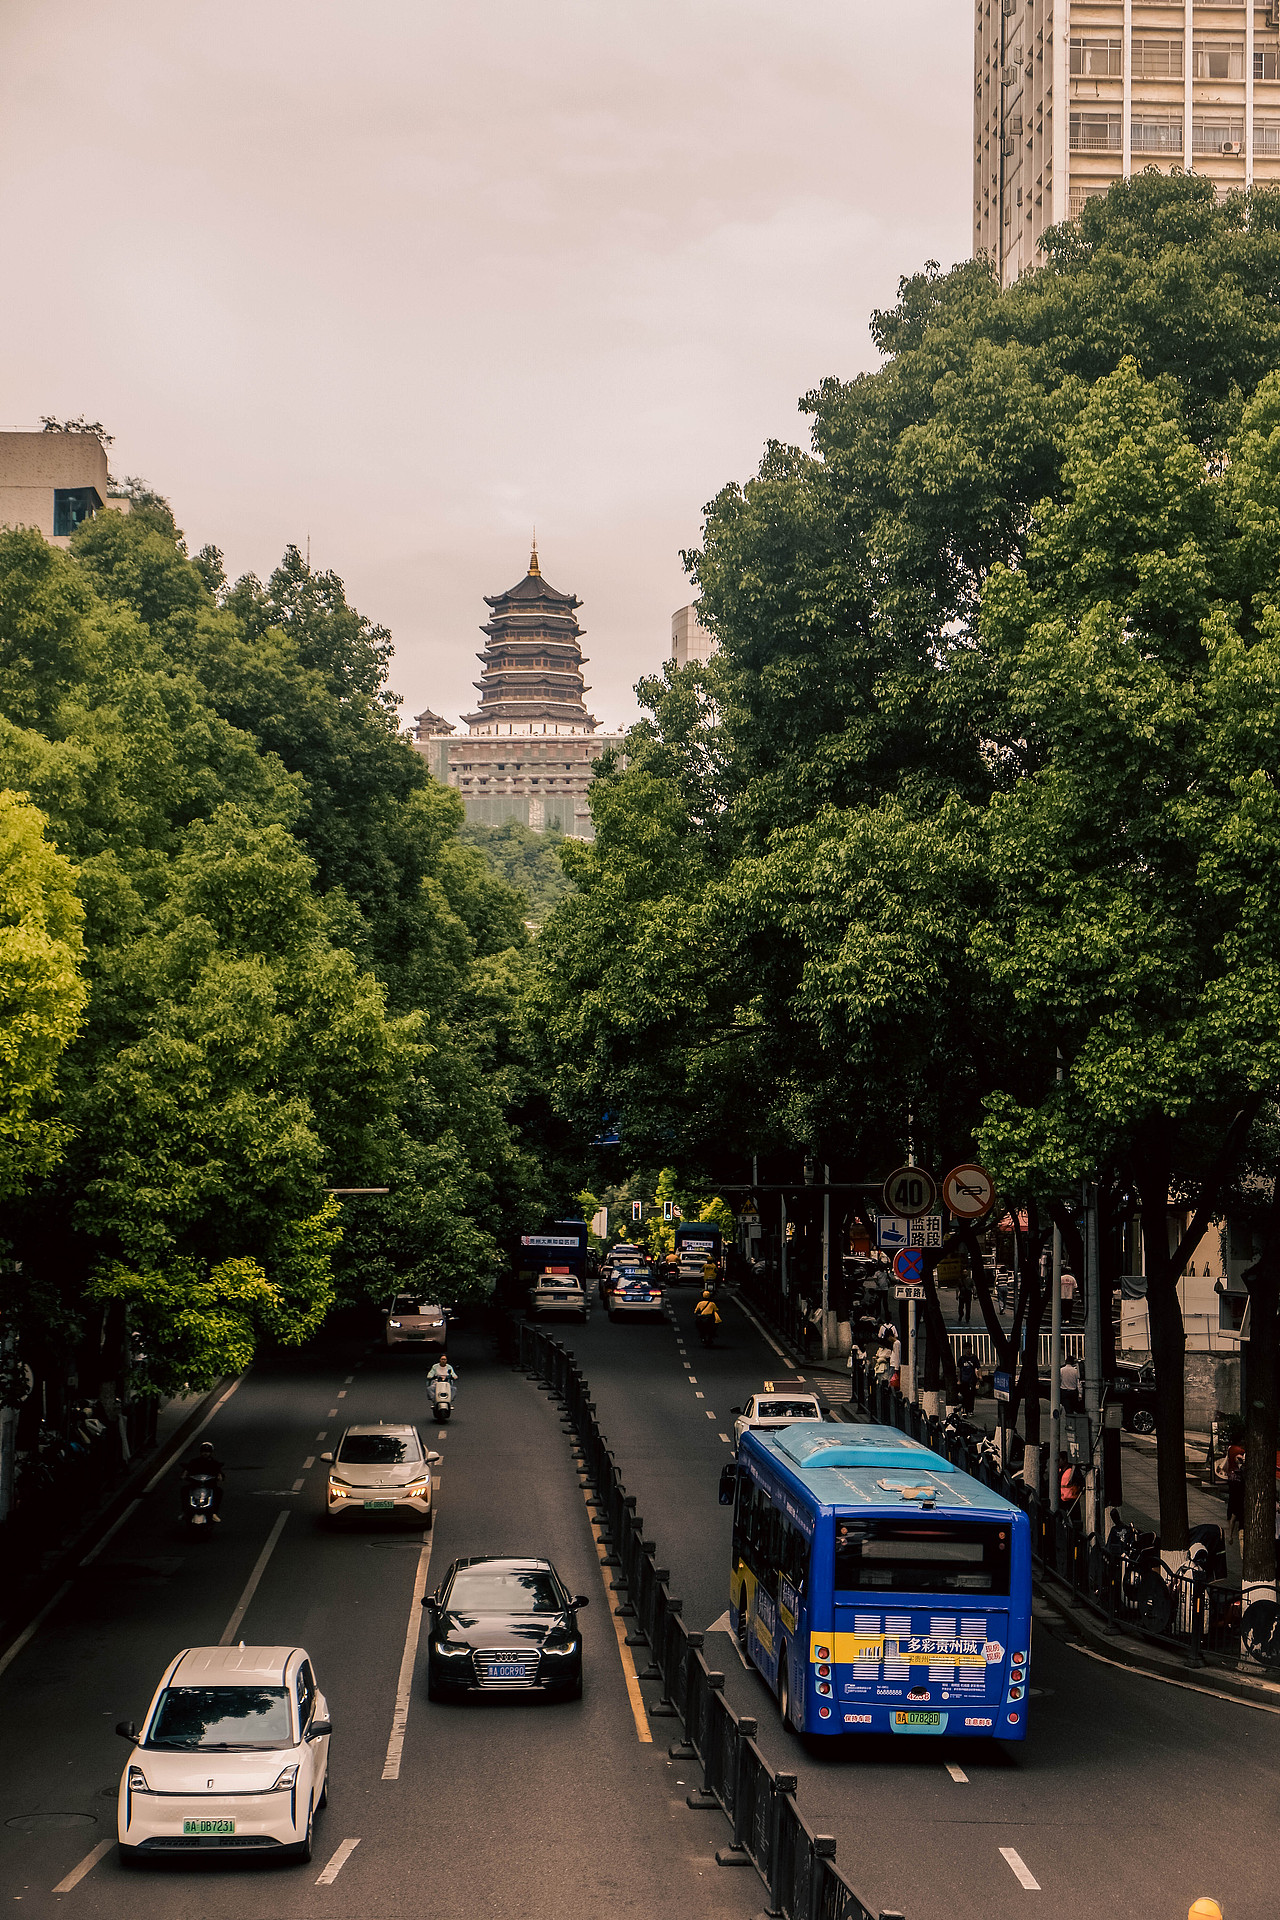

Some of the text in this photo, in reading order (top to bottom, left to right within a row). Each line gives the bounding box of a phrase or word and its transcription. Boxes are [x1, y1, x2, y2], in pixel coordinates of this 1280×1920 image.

[895, 1179, 922, 1207] 40
[910, 1217, 940, 1232] 监拍
[910, 1232, 940, 1247] 路段
[896, 1287, 927, 1298] 严管路
[907, 1637, 978, 1654] 多彩贵州城
